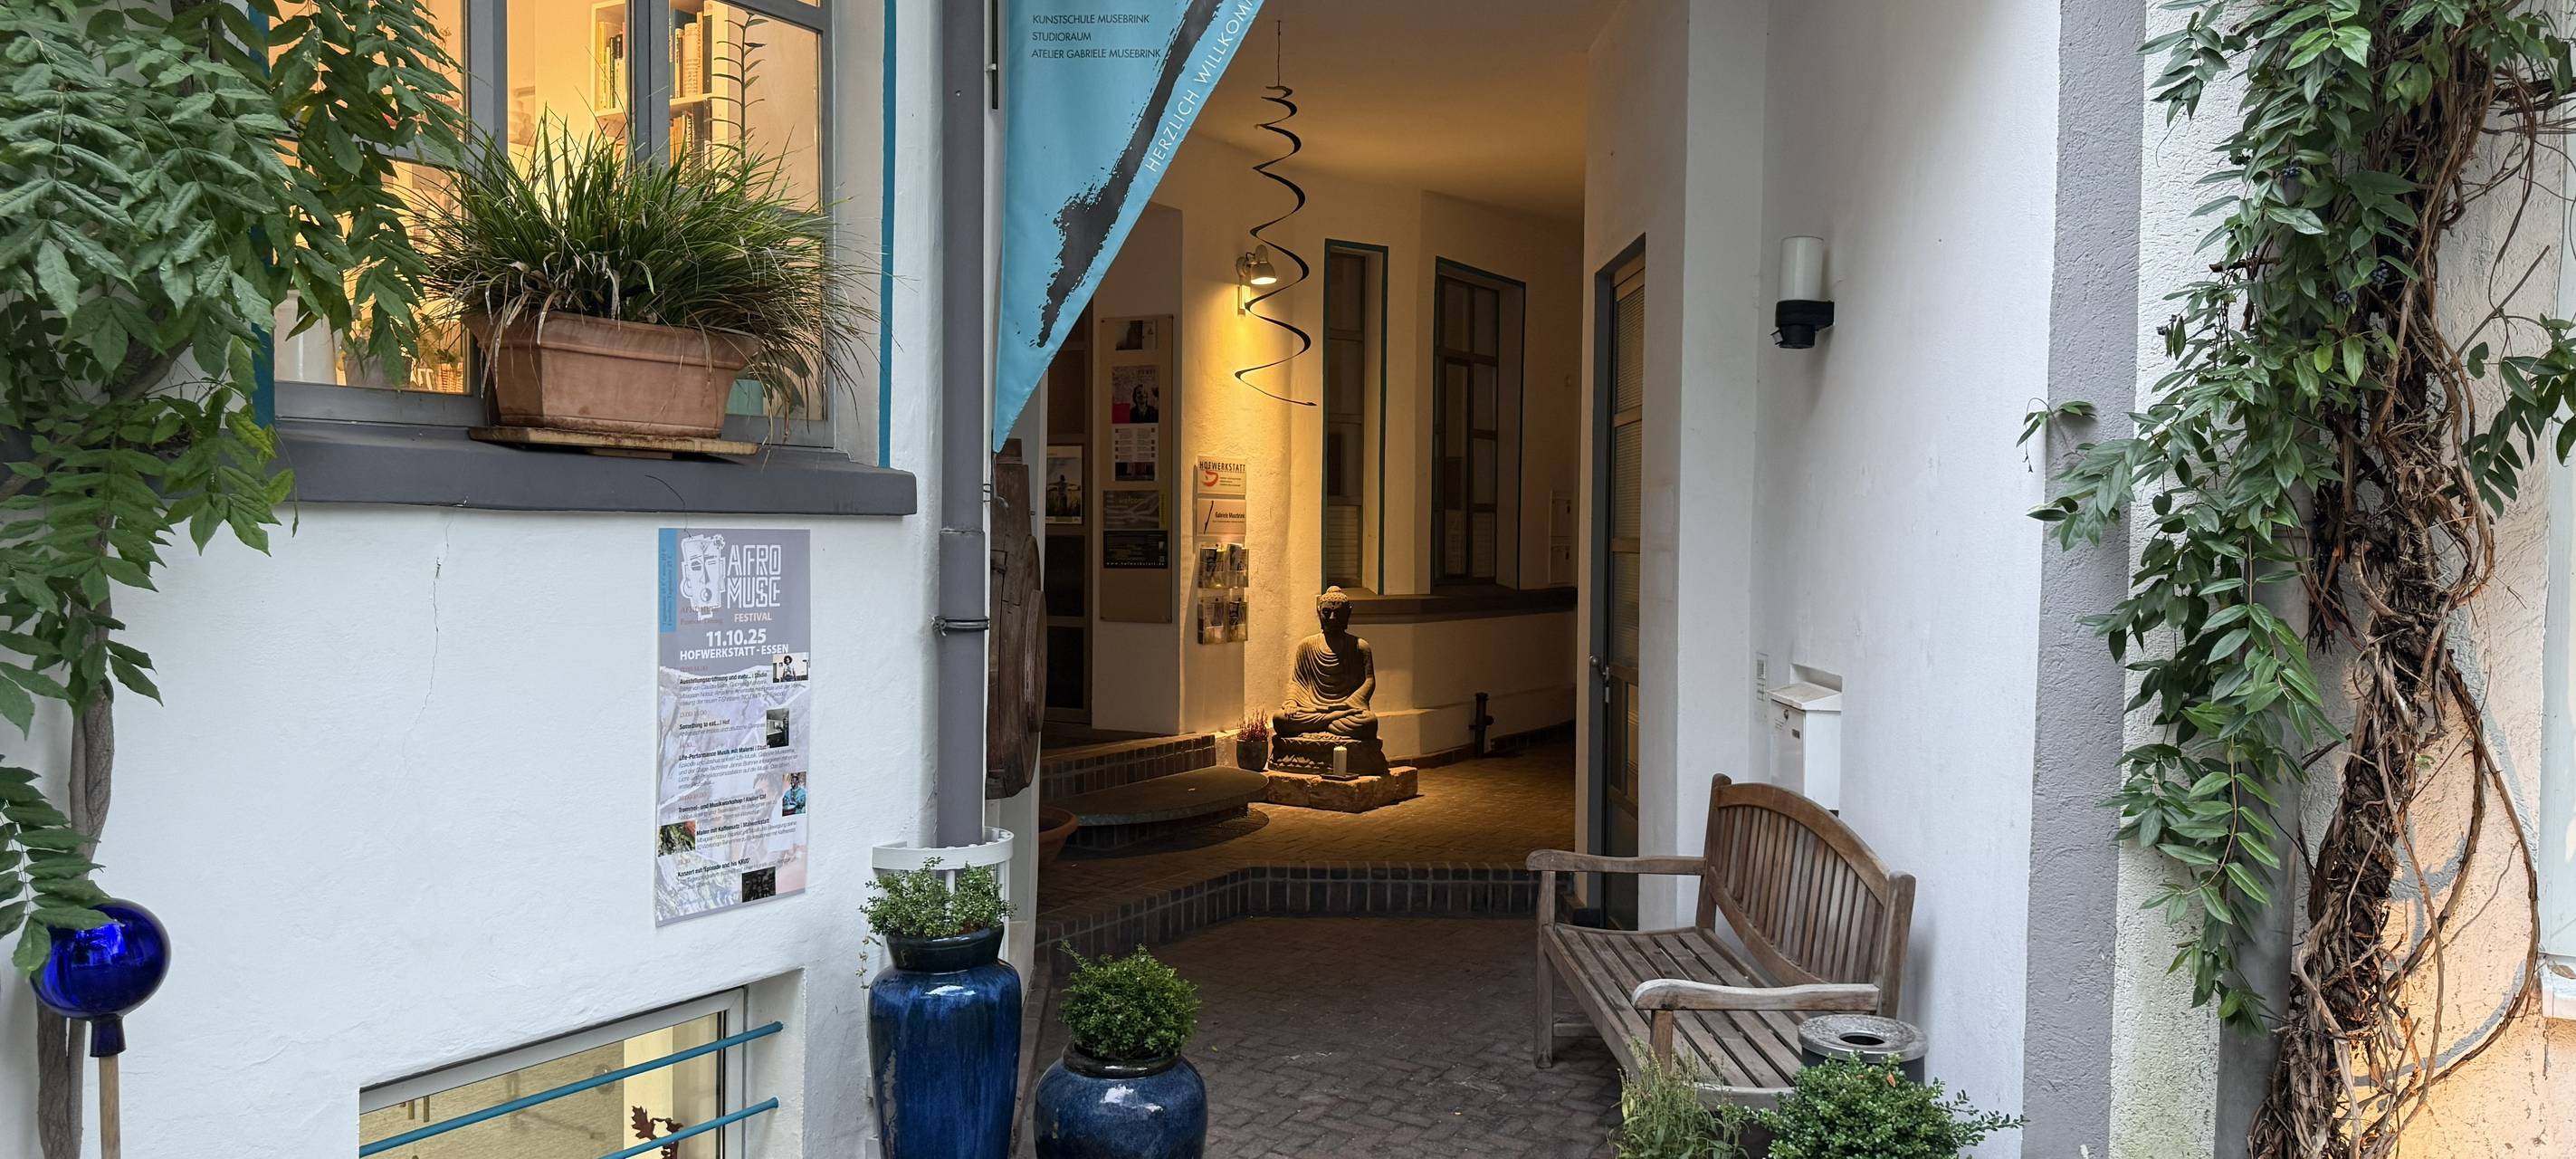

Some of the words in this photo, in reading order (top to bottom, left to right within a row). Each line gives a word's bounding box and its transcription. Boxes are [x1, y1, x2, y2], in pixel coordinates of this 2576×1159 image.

[1032, 14, 1096, 24] KUNSTSCHULE
[1096, 14, 1150, 24] MUSEBRINK
[1032, 31, 1092, 42] STUDIORAUM
[1031, 49, 1064, 59] ATELIER
[1066, 49, 1107, 59] GABRIELE
[1108, 48, 1161, 59] MUSEBRINK
[1145, 90, 1200, 173] HERZLICH
[1194, 0, 1254, 83] WILLKOM
[1199, 461, 1245, 471] HOFWERKSTATT
[727, 544, 782, 576] AFRO
[727, 576, 781, 609] MUSE
[734, 612, 772, 623] FESTIVAL
[706, 628, 767, 647] 11.10.25
[680, 646, 755, 660] HOFWERKSTATT
[761, 644, 789, 654] ESSEN
